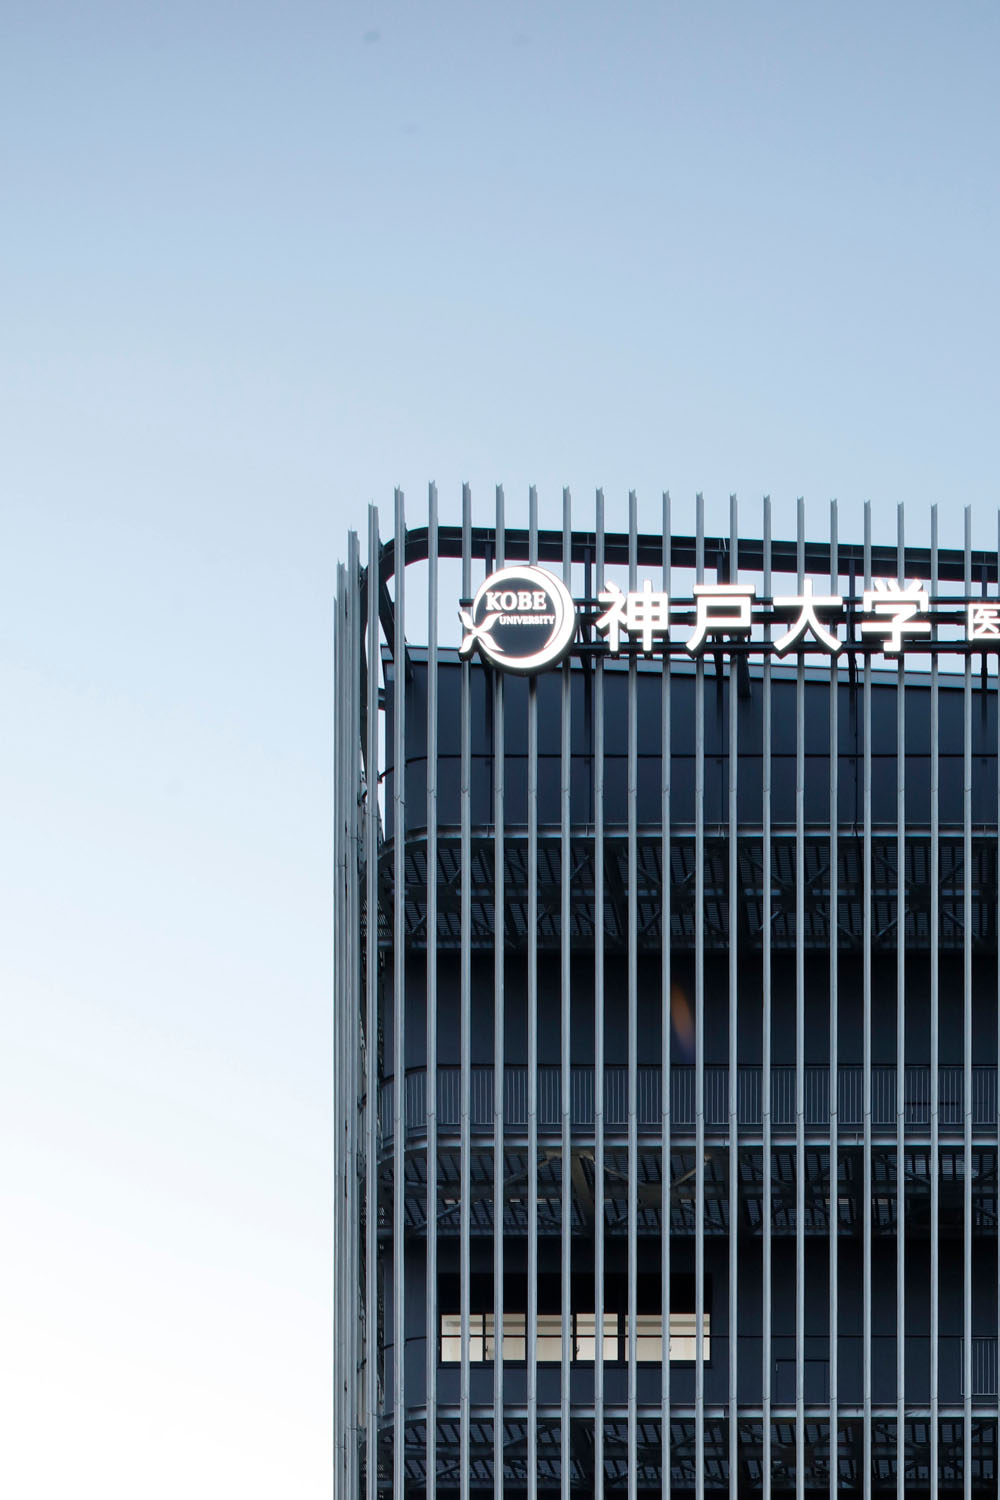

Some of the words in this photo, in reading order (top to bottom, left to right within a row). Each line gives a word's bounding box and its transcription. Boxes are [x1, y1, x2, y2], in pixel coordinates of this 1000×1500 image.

[485, 591, 547, 611] KOBE
[499, 615, 556, 625] UNIVERSITY
[596, 578, 931, 652] 神戸大学
